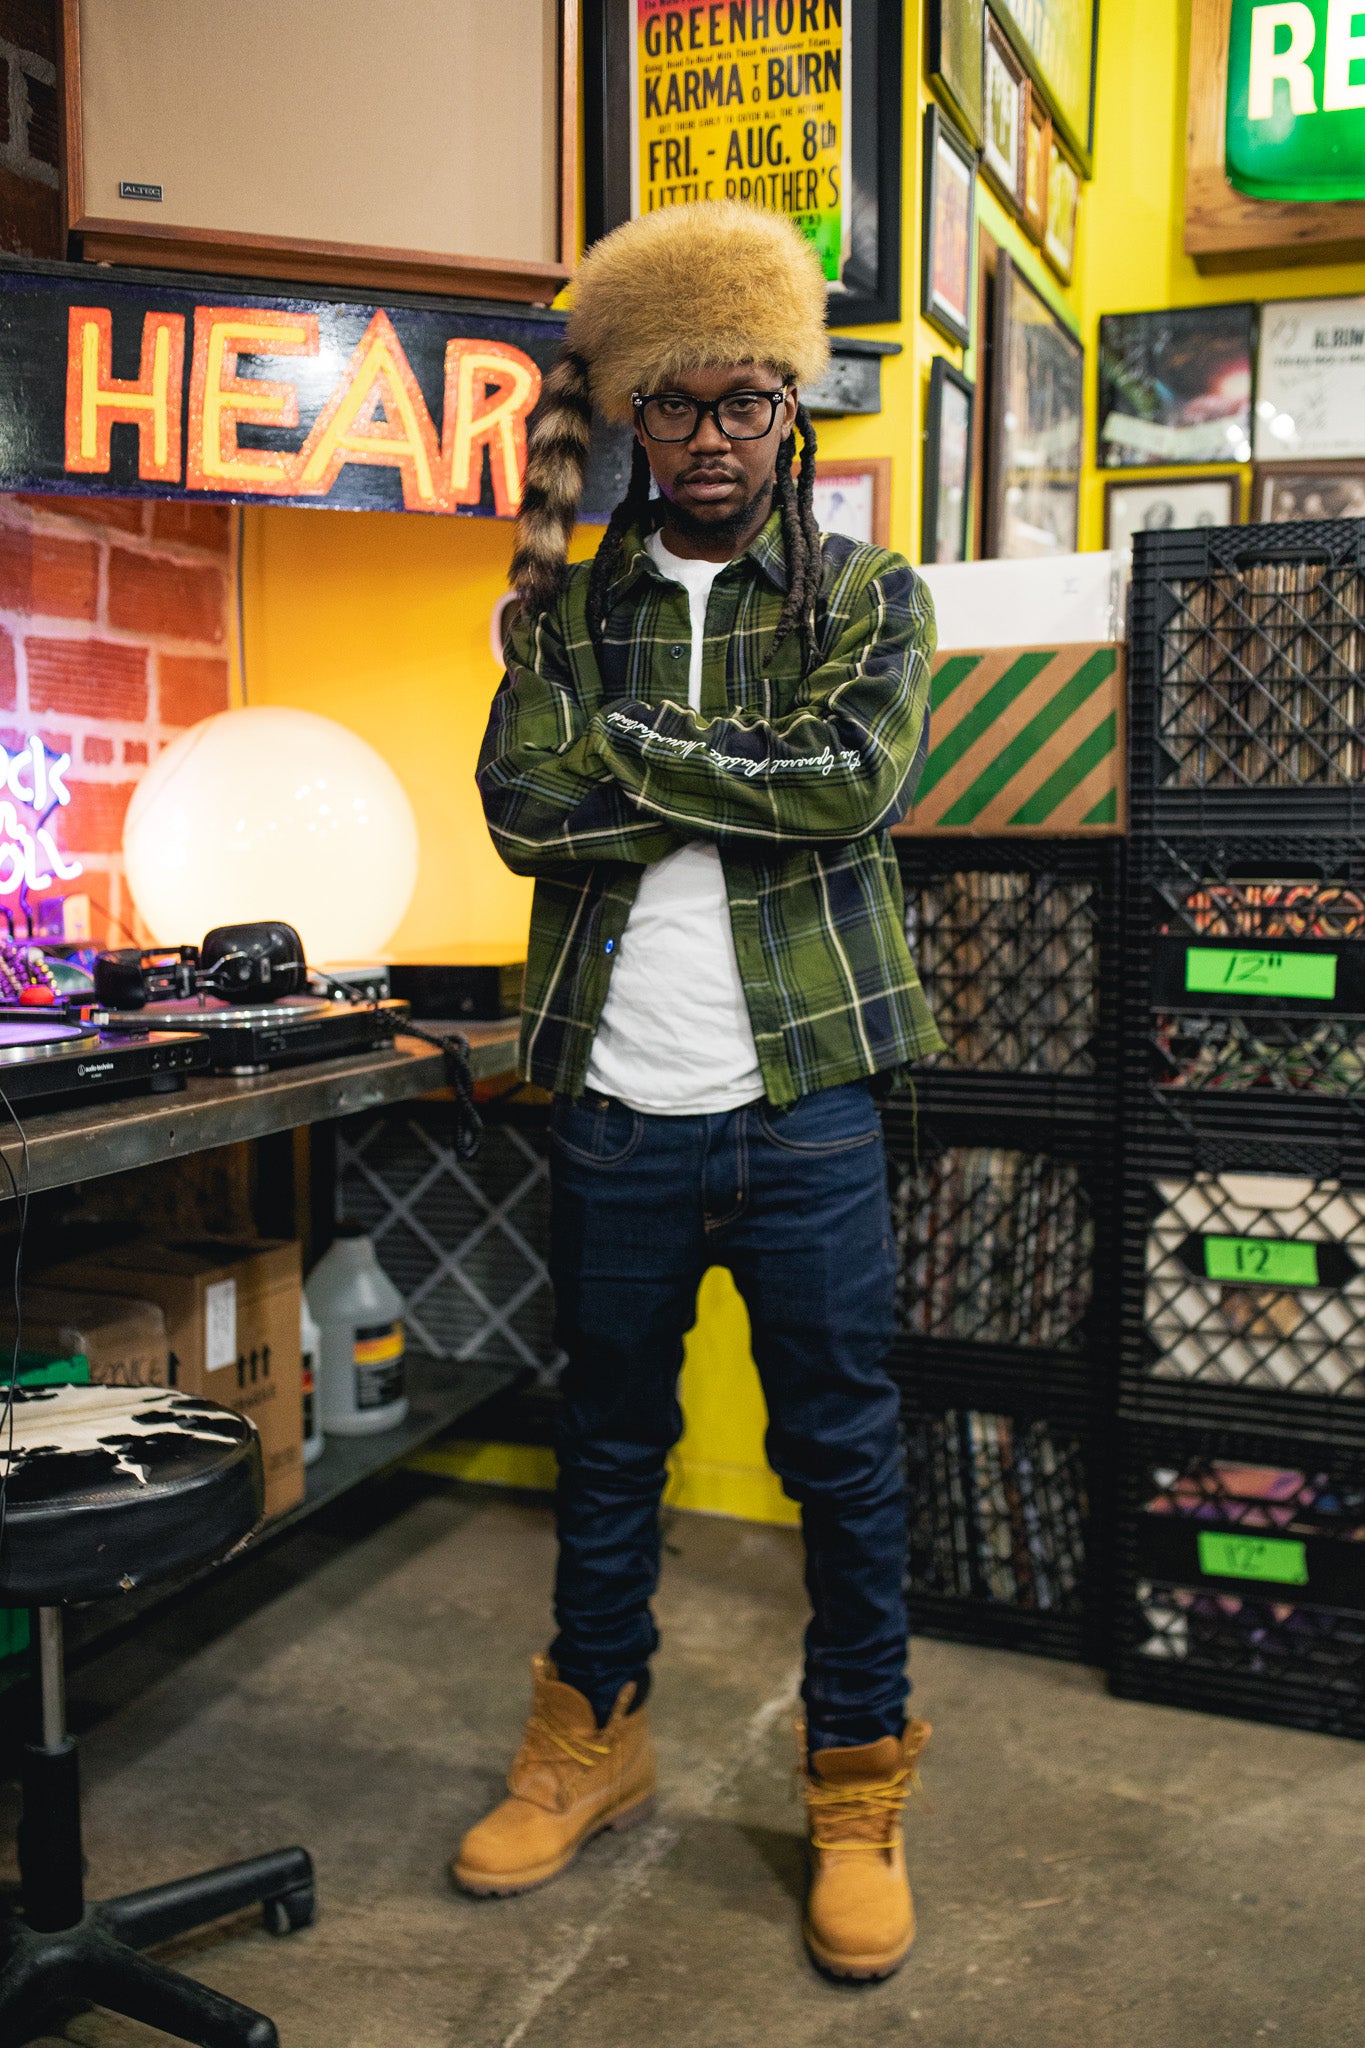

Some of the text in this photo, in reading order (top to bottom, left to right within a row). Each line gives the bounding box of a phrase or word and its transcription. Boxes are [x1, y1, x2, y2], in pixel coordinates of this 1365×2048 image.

[645, 0, 842, 57] GREENHORN
[645, 64, 744, 118] KARMA
[767, 48, 842, 101] BURN
[1246, 1, 1365, 120] RE
[649, 136, 698, 182] FRI.
[725, 123, 791, 171] AUG.
[802, 119, 836, 162] 8th
[64, 306, 543, 517] HEAR
[709, 748, 769, 778] Public
[770, 745, 835, 776] General
